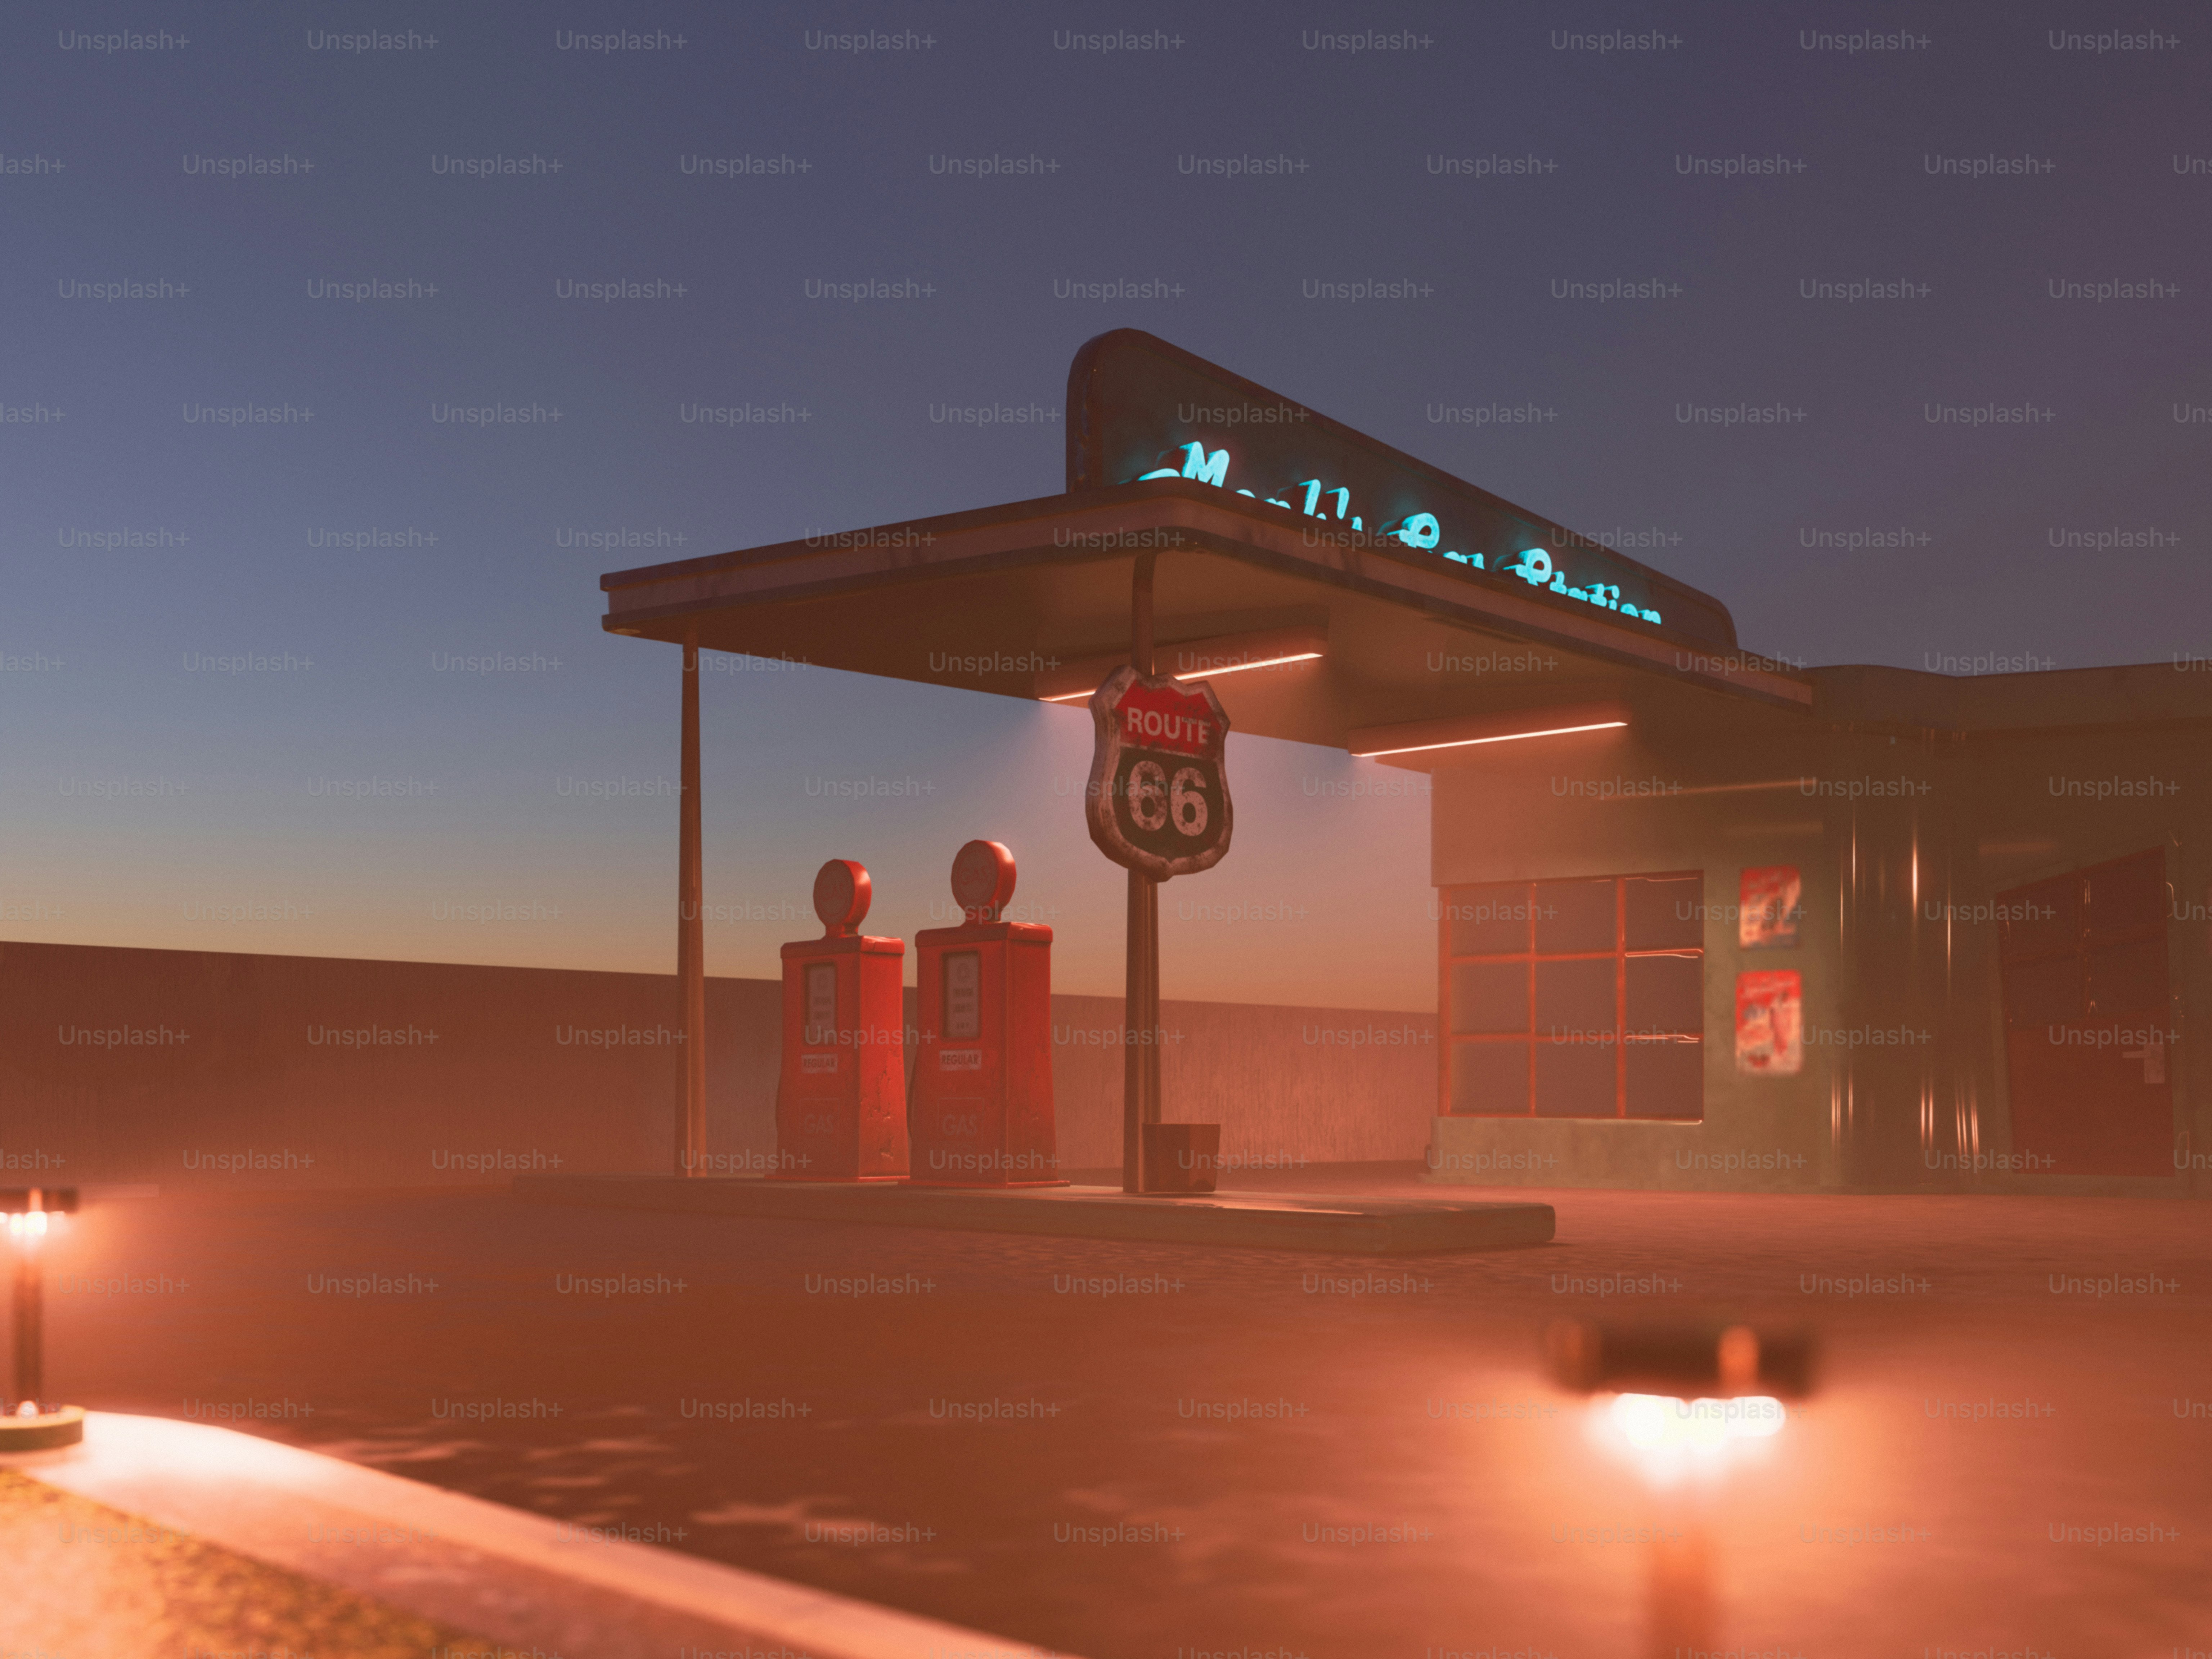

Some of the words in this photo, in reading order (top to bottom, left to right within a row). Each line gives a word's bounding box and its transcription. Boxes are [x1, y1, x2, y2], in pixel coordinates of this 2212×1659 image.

[1127, 707, 1211, 744] ROUTE
[1128, 760, 1208, 836] 66
[803, 1058, 835, 1068] REGULAR
[941, 1054, 978, 1065] REGULAR
[804, 1114, 834, 1134] GAS
[942, 1114, 977, 1136] GAS
